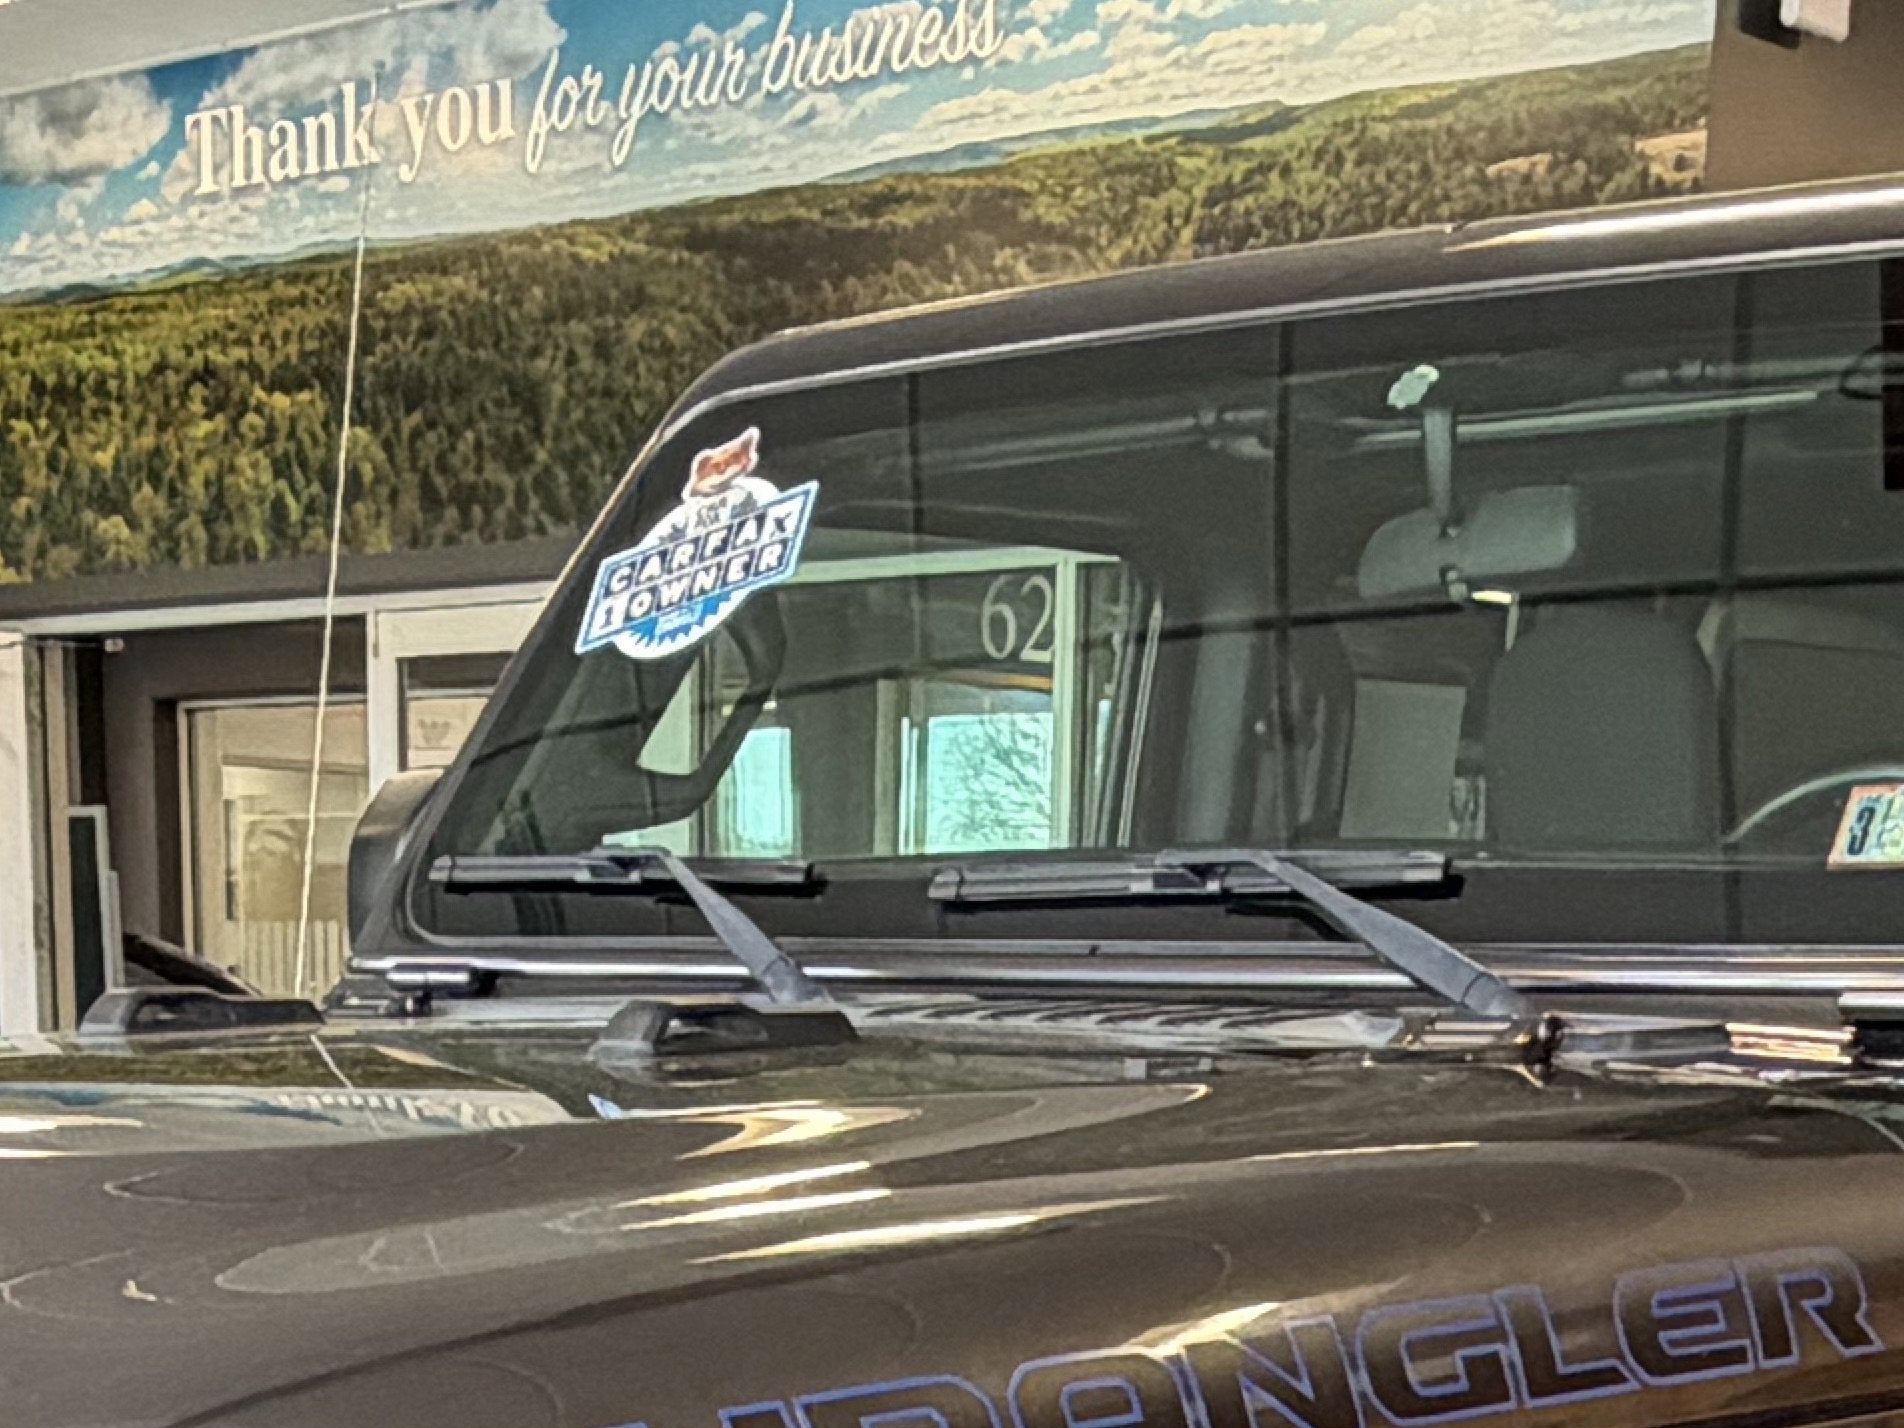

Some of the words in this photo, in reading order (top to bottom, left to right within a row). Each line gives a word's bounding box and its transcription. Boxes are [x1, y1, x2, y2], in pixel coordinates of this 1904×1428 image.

[184, 79, 377, 195] Thank
[399, 76, 516, 181] you
[525, 47, 609, 173] for
[610, 43, 757, 167] your
[761, 0, 1006, 96] business
[606, 508, 793, 596] CARFAX
[627, 541, 786, 618] OWNER
